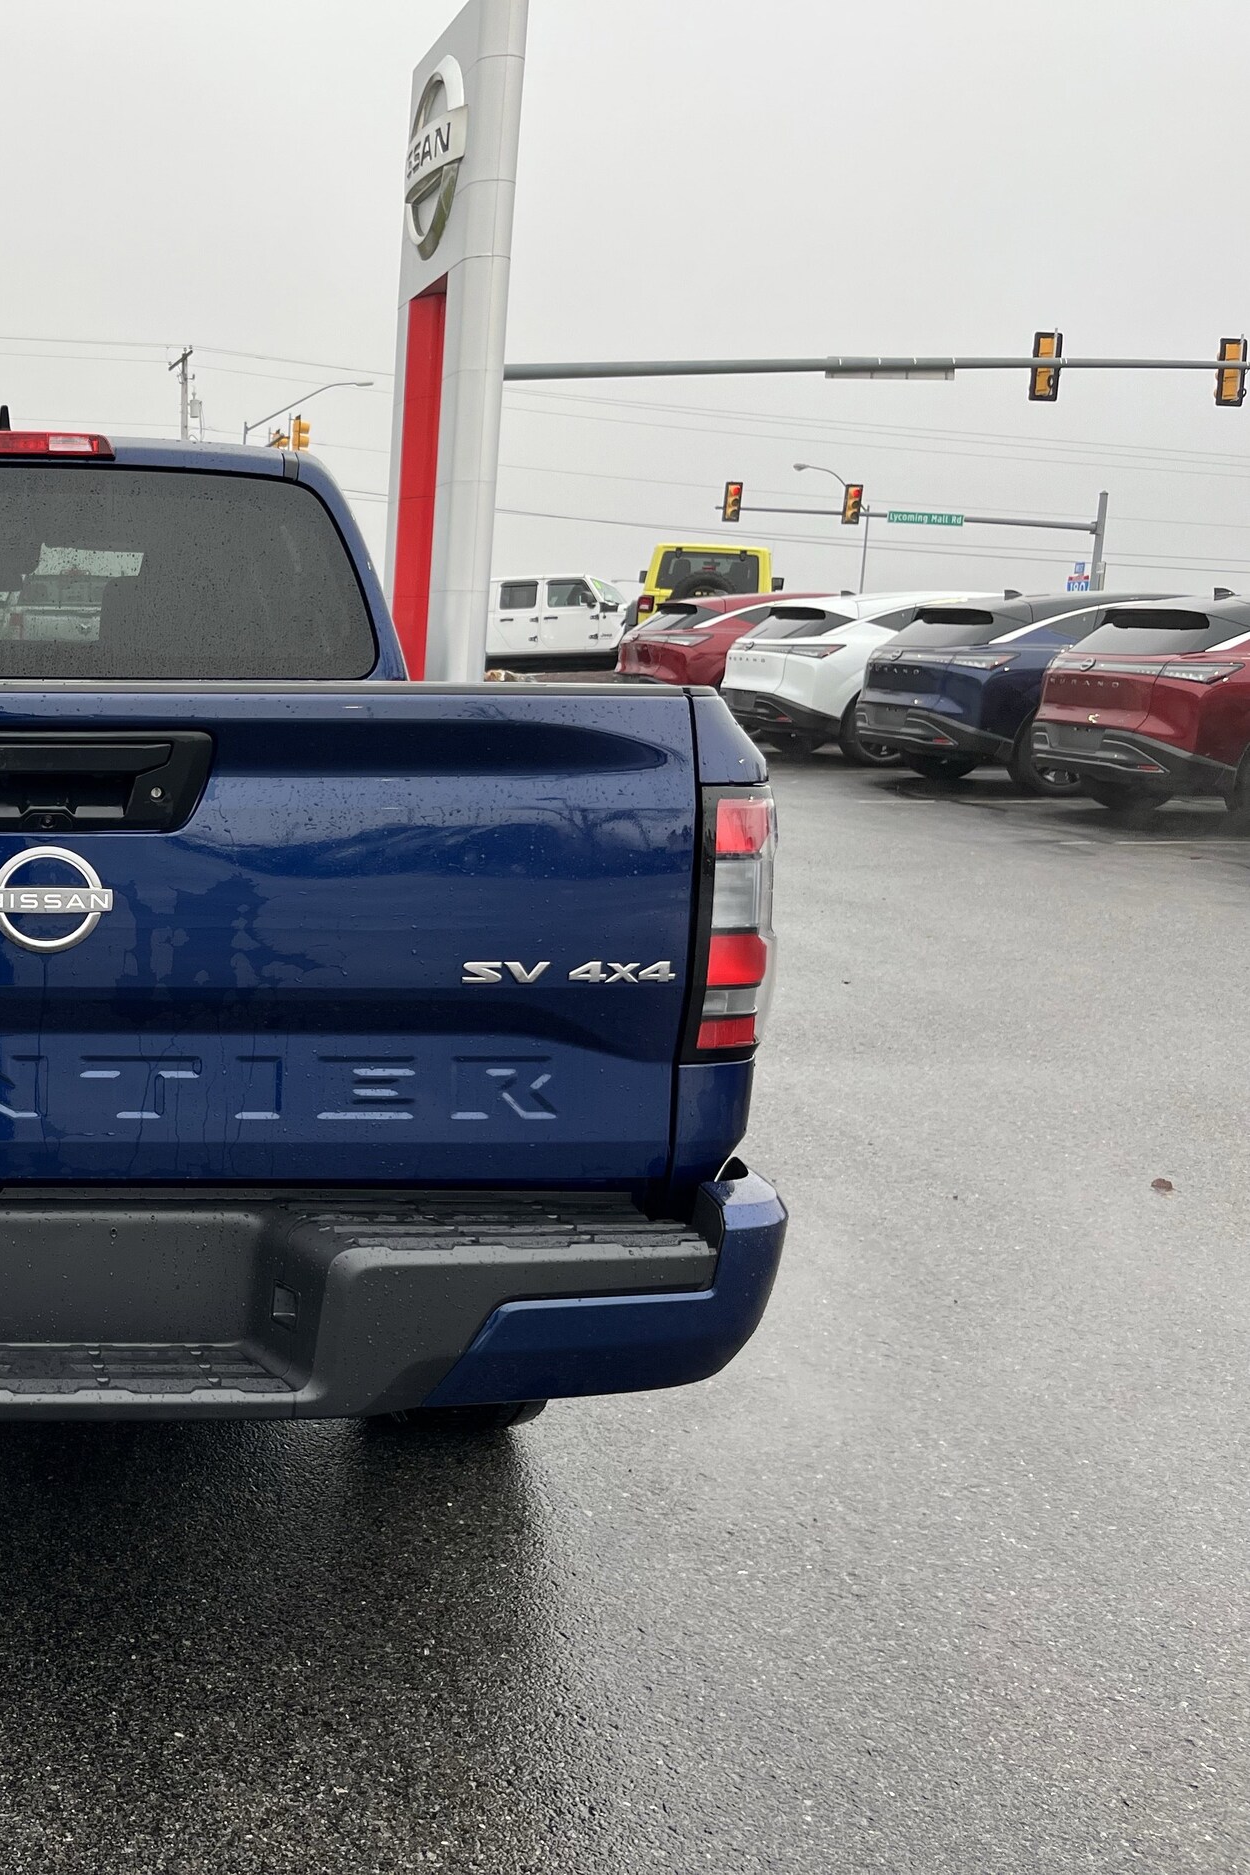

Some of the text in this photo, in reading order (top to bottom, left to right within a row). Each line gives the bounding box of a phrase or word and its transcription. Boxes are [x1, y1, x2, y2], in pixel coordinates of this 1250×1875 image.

[889, 512, 962, 525] Lycoming Mall Rd
[461, 960, 677, 984] SV 4x4
